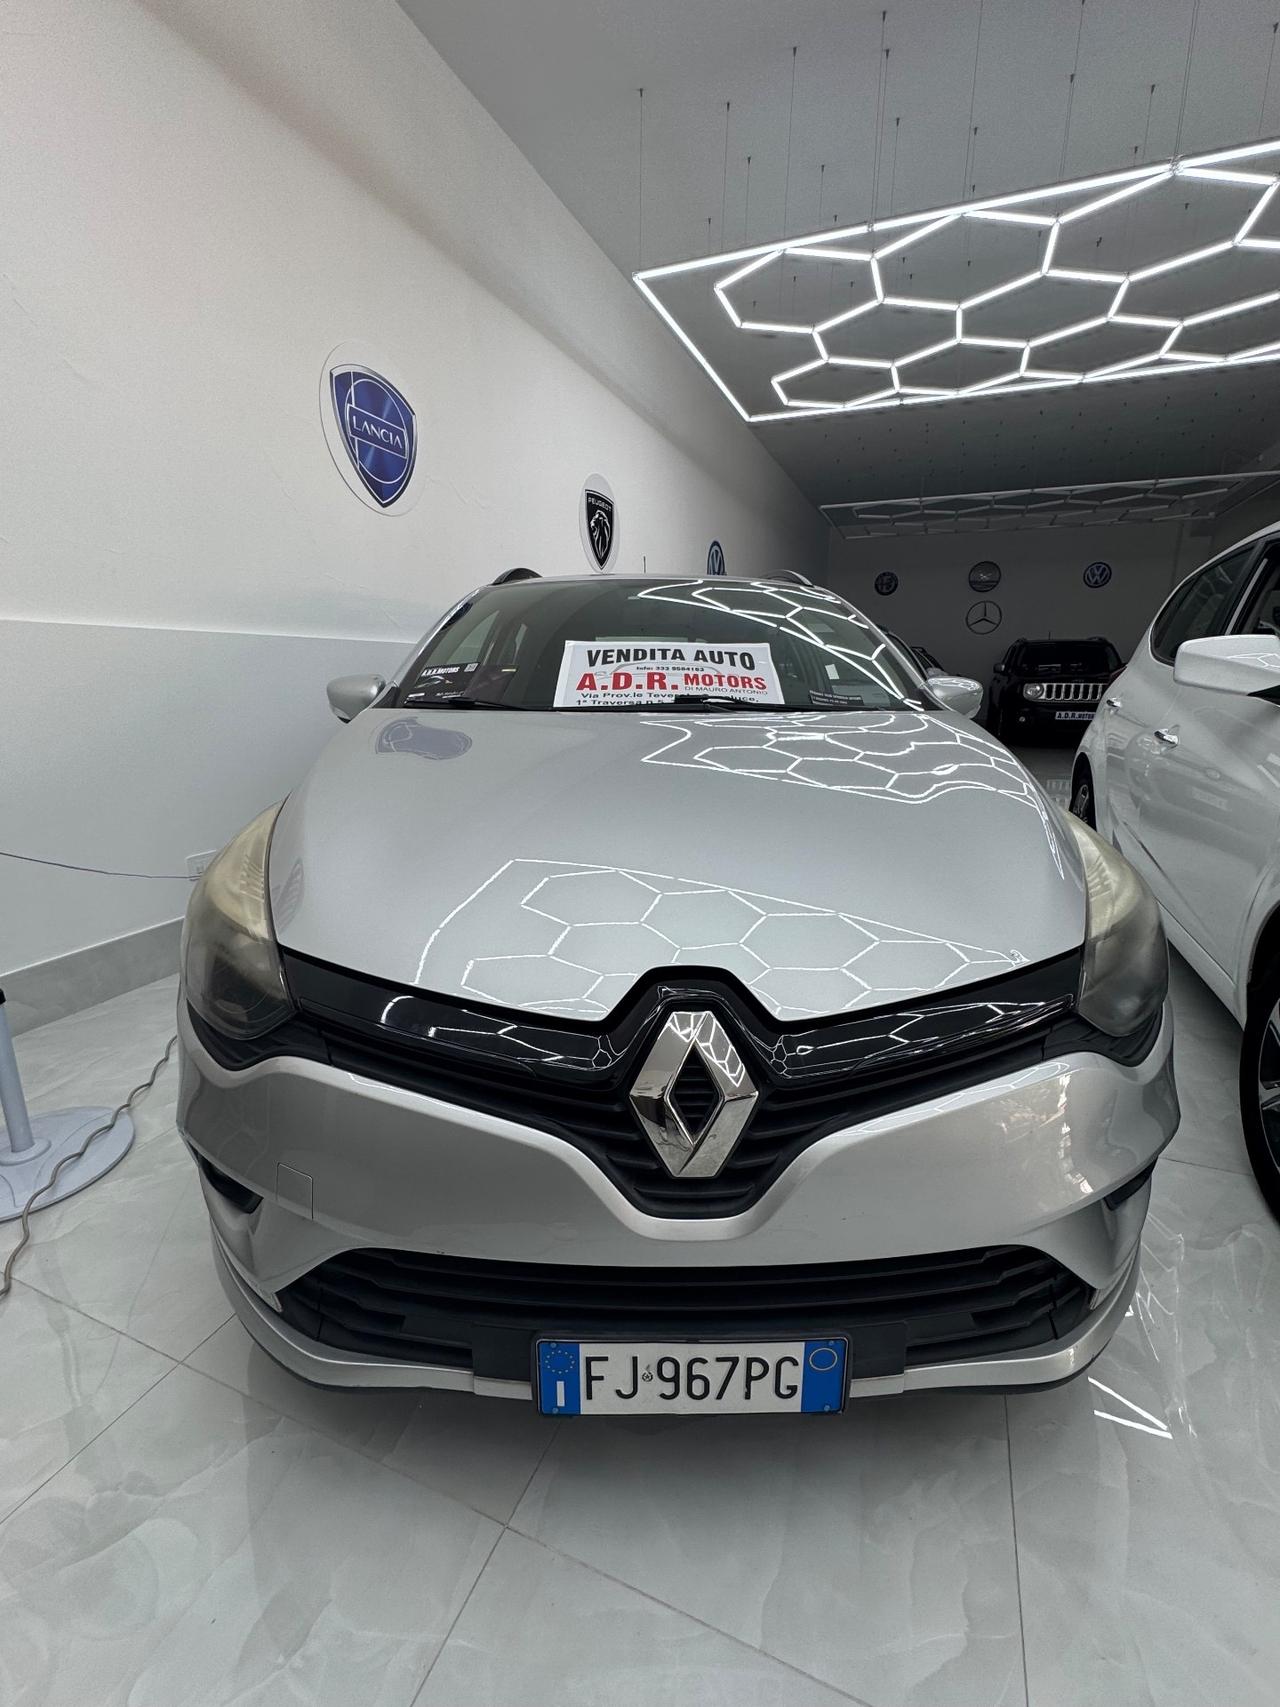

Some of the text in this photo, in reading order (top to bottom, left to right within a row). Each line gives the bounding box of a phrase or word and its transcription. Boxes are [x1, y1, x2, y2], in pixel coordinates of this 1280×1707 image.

[352, 415, 403, 449] LANCIA
[587, 648, 756, 671] VENDITA AUTO
[576, 672, 767, 691] A.D.R. MOTORS
[695, 686, 728, 694] MAURO
[729, 688, 768, 696] ANTONIO
